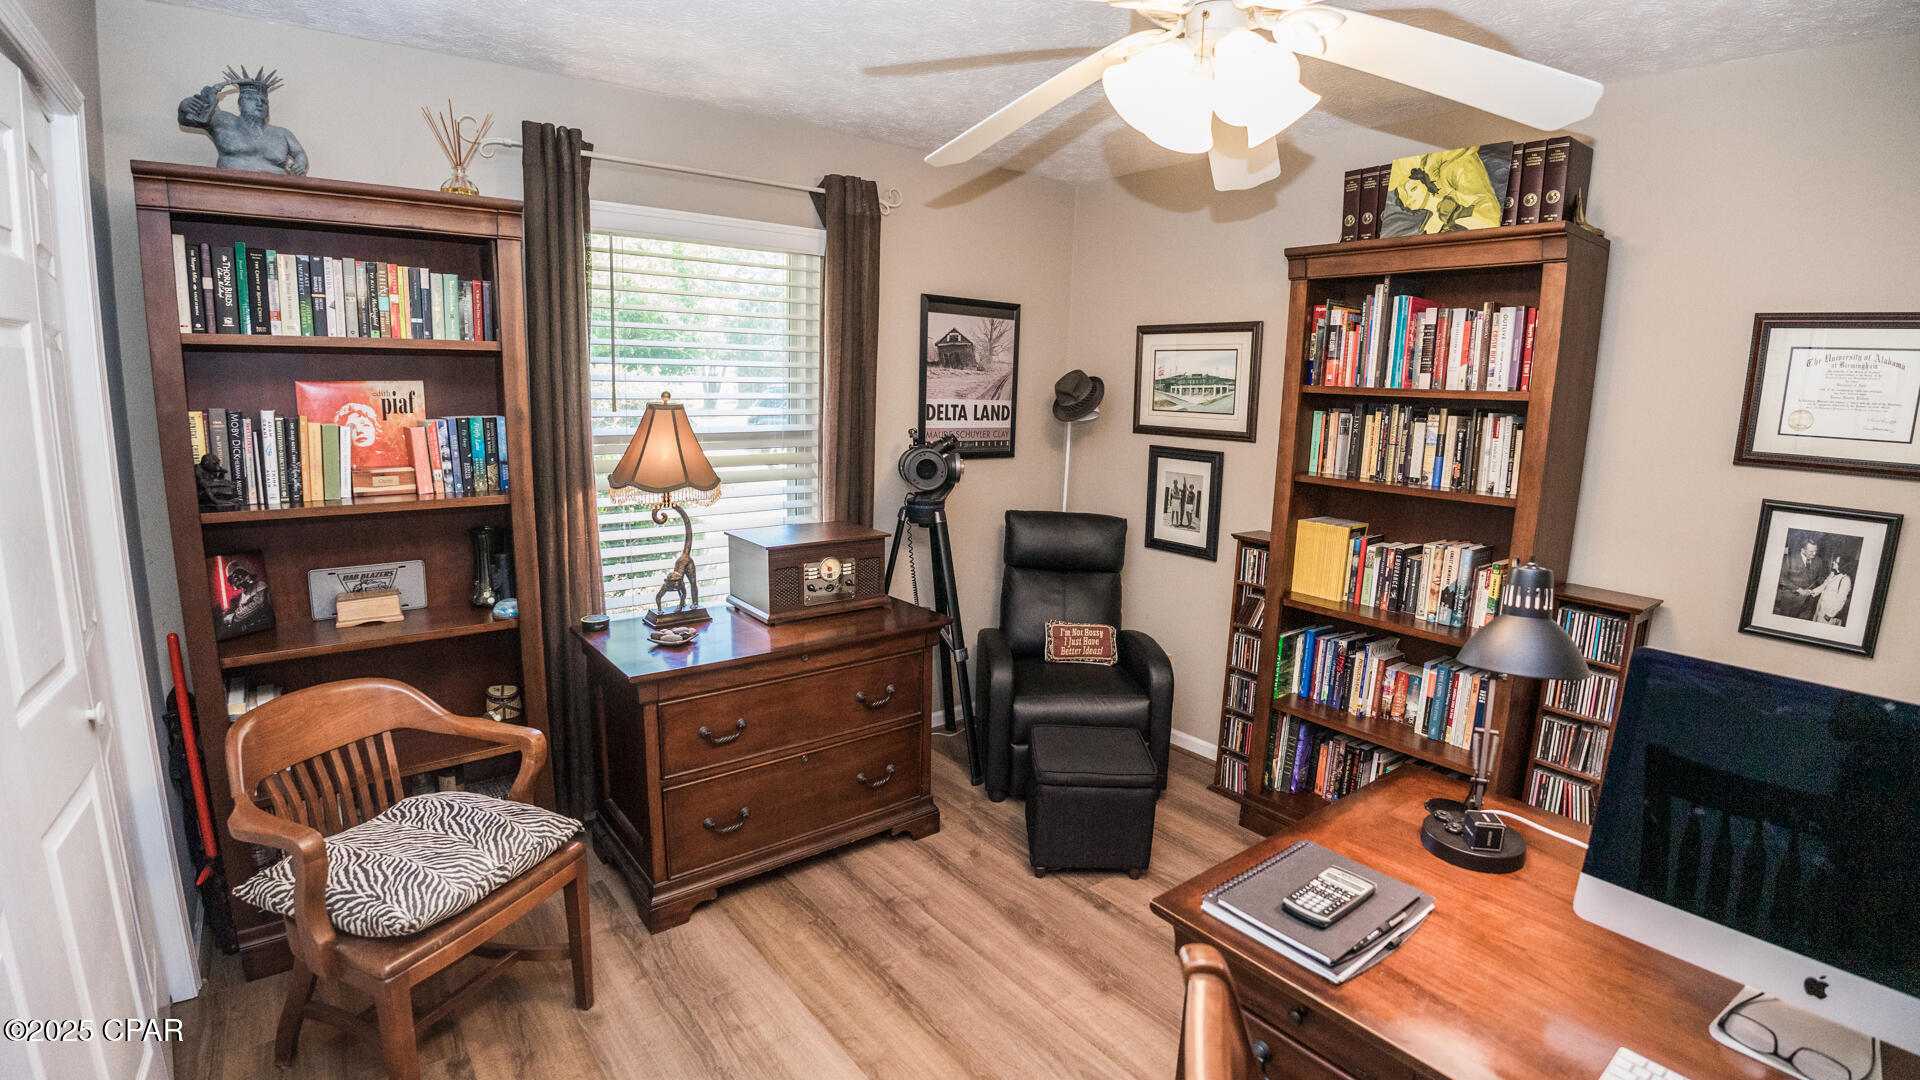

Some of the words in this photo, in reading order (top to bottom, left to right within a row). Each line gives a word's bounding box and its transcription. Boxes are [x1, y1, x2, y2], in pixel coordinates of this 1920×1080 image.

[222, 262, 231, 287] THORN
[225, 287, 233, 307] BIRDS
[381, 390, 416, 421] piaf
[926, 404, 968, 421] DELTA
[973, 404, 1011, 421] LAND
[230, 414, 239, 438] MOBY
[956, 430, 990, 439] SCHUYLER
[992, 431, 1009, 439] CLAY
[232, 440, 241, 459] DICK
[360, 570, 395, 580] BLAZERS
[1392, 555, 1402, 588] ENDURANCE
[1060, 628, 1071, 637] I'm
[1072, 628, 1084, 637] Not
[1084, 628, 1104, 639] Bossy
[1064, 637, 1068, 646] I
[1068, 637, 1082, 648] Just
[1083, 637, 1100, 646] Have
[1060, 646, 1082, 656] Better
[1082, 646, 1104, 656] Ideas!
[1336, 656, 1345, 674] 1776
